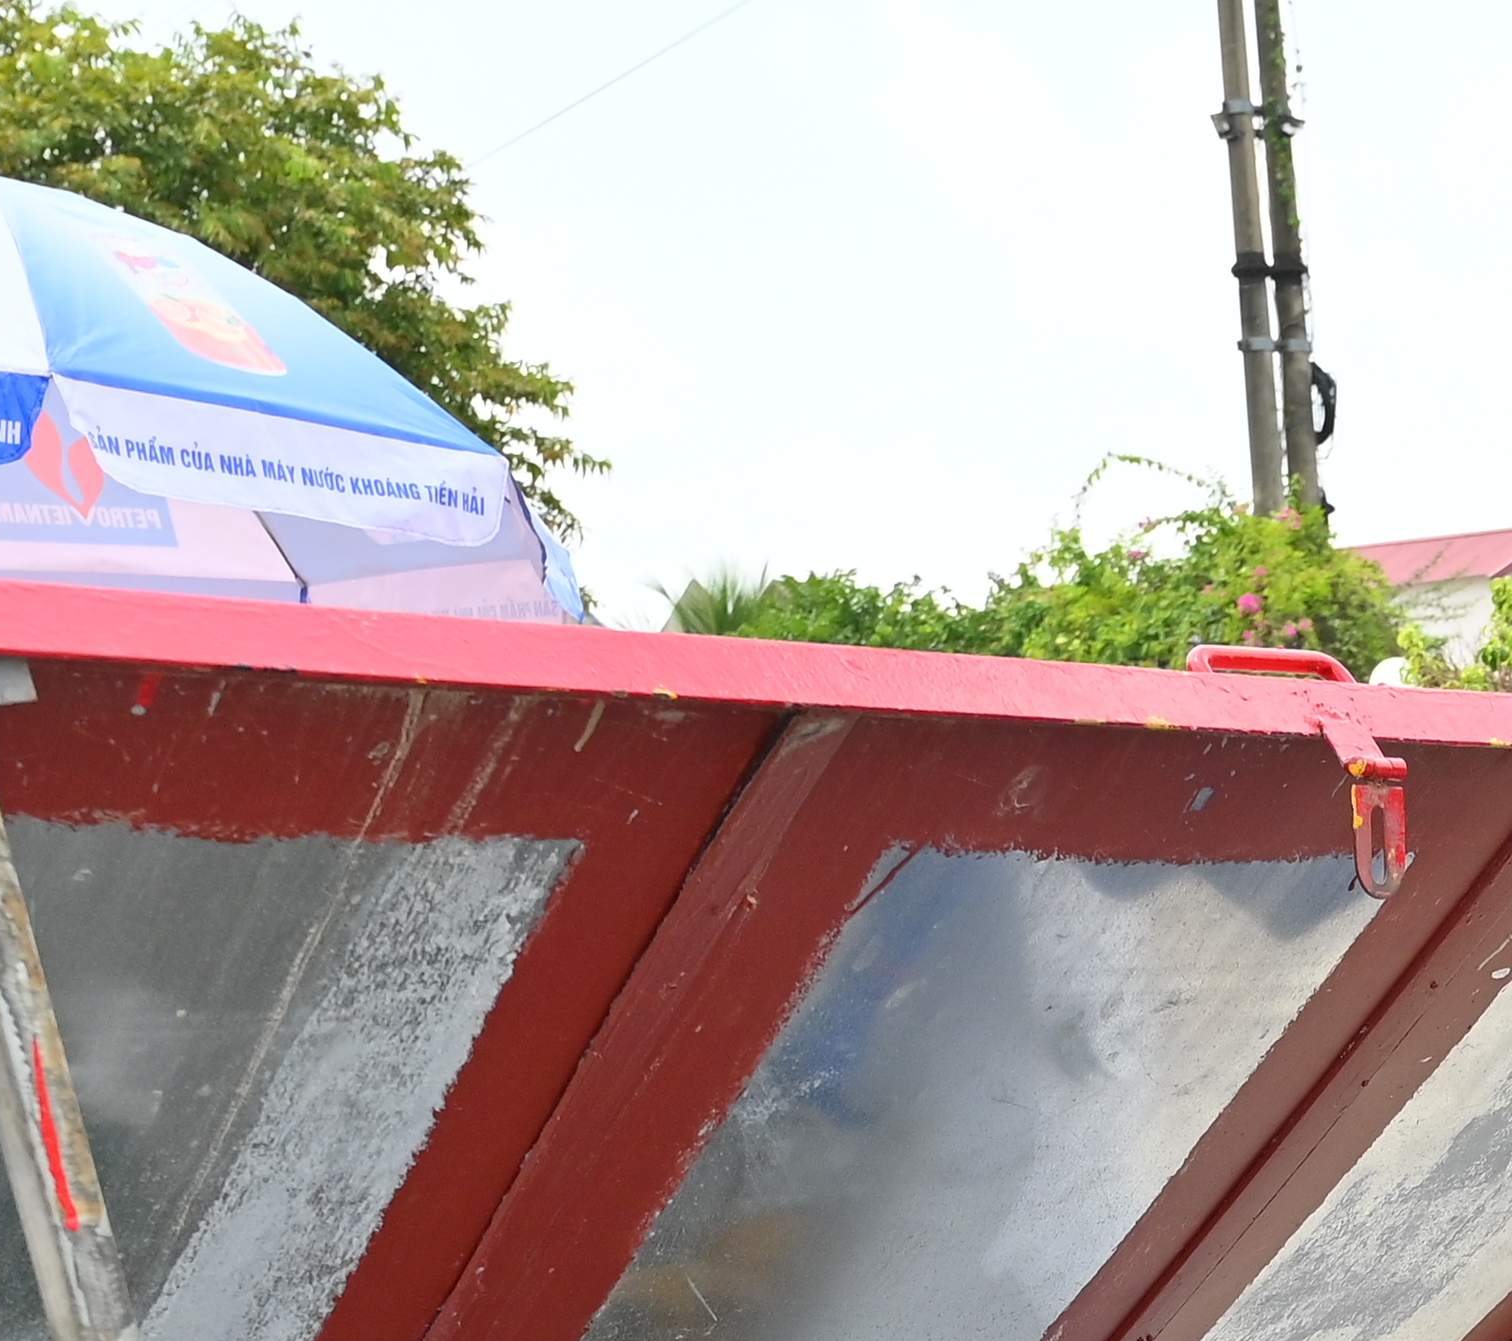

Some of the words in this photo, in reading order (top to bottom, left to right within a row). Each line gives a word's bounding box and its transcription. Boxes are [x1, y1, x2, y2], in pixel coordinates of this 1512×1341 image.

[125, 436, 176, 466] PHẨM
[180, 441, 216, 473] CỦA
[220, 453, 257, 478] NHÀ
[261, 459, 295, 485] MÁY
[301, 466, 346, 493] NƯỚC
[349, 477, 421, 501] KHOÁNG
[462, 486, 485, 516] HẢI
